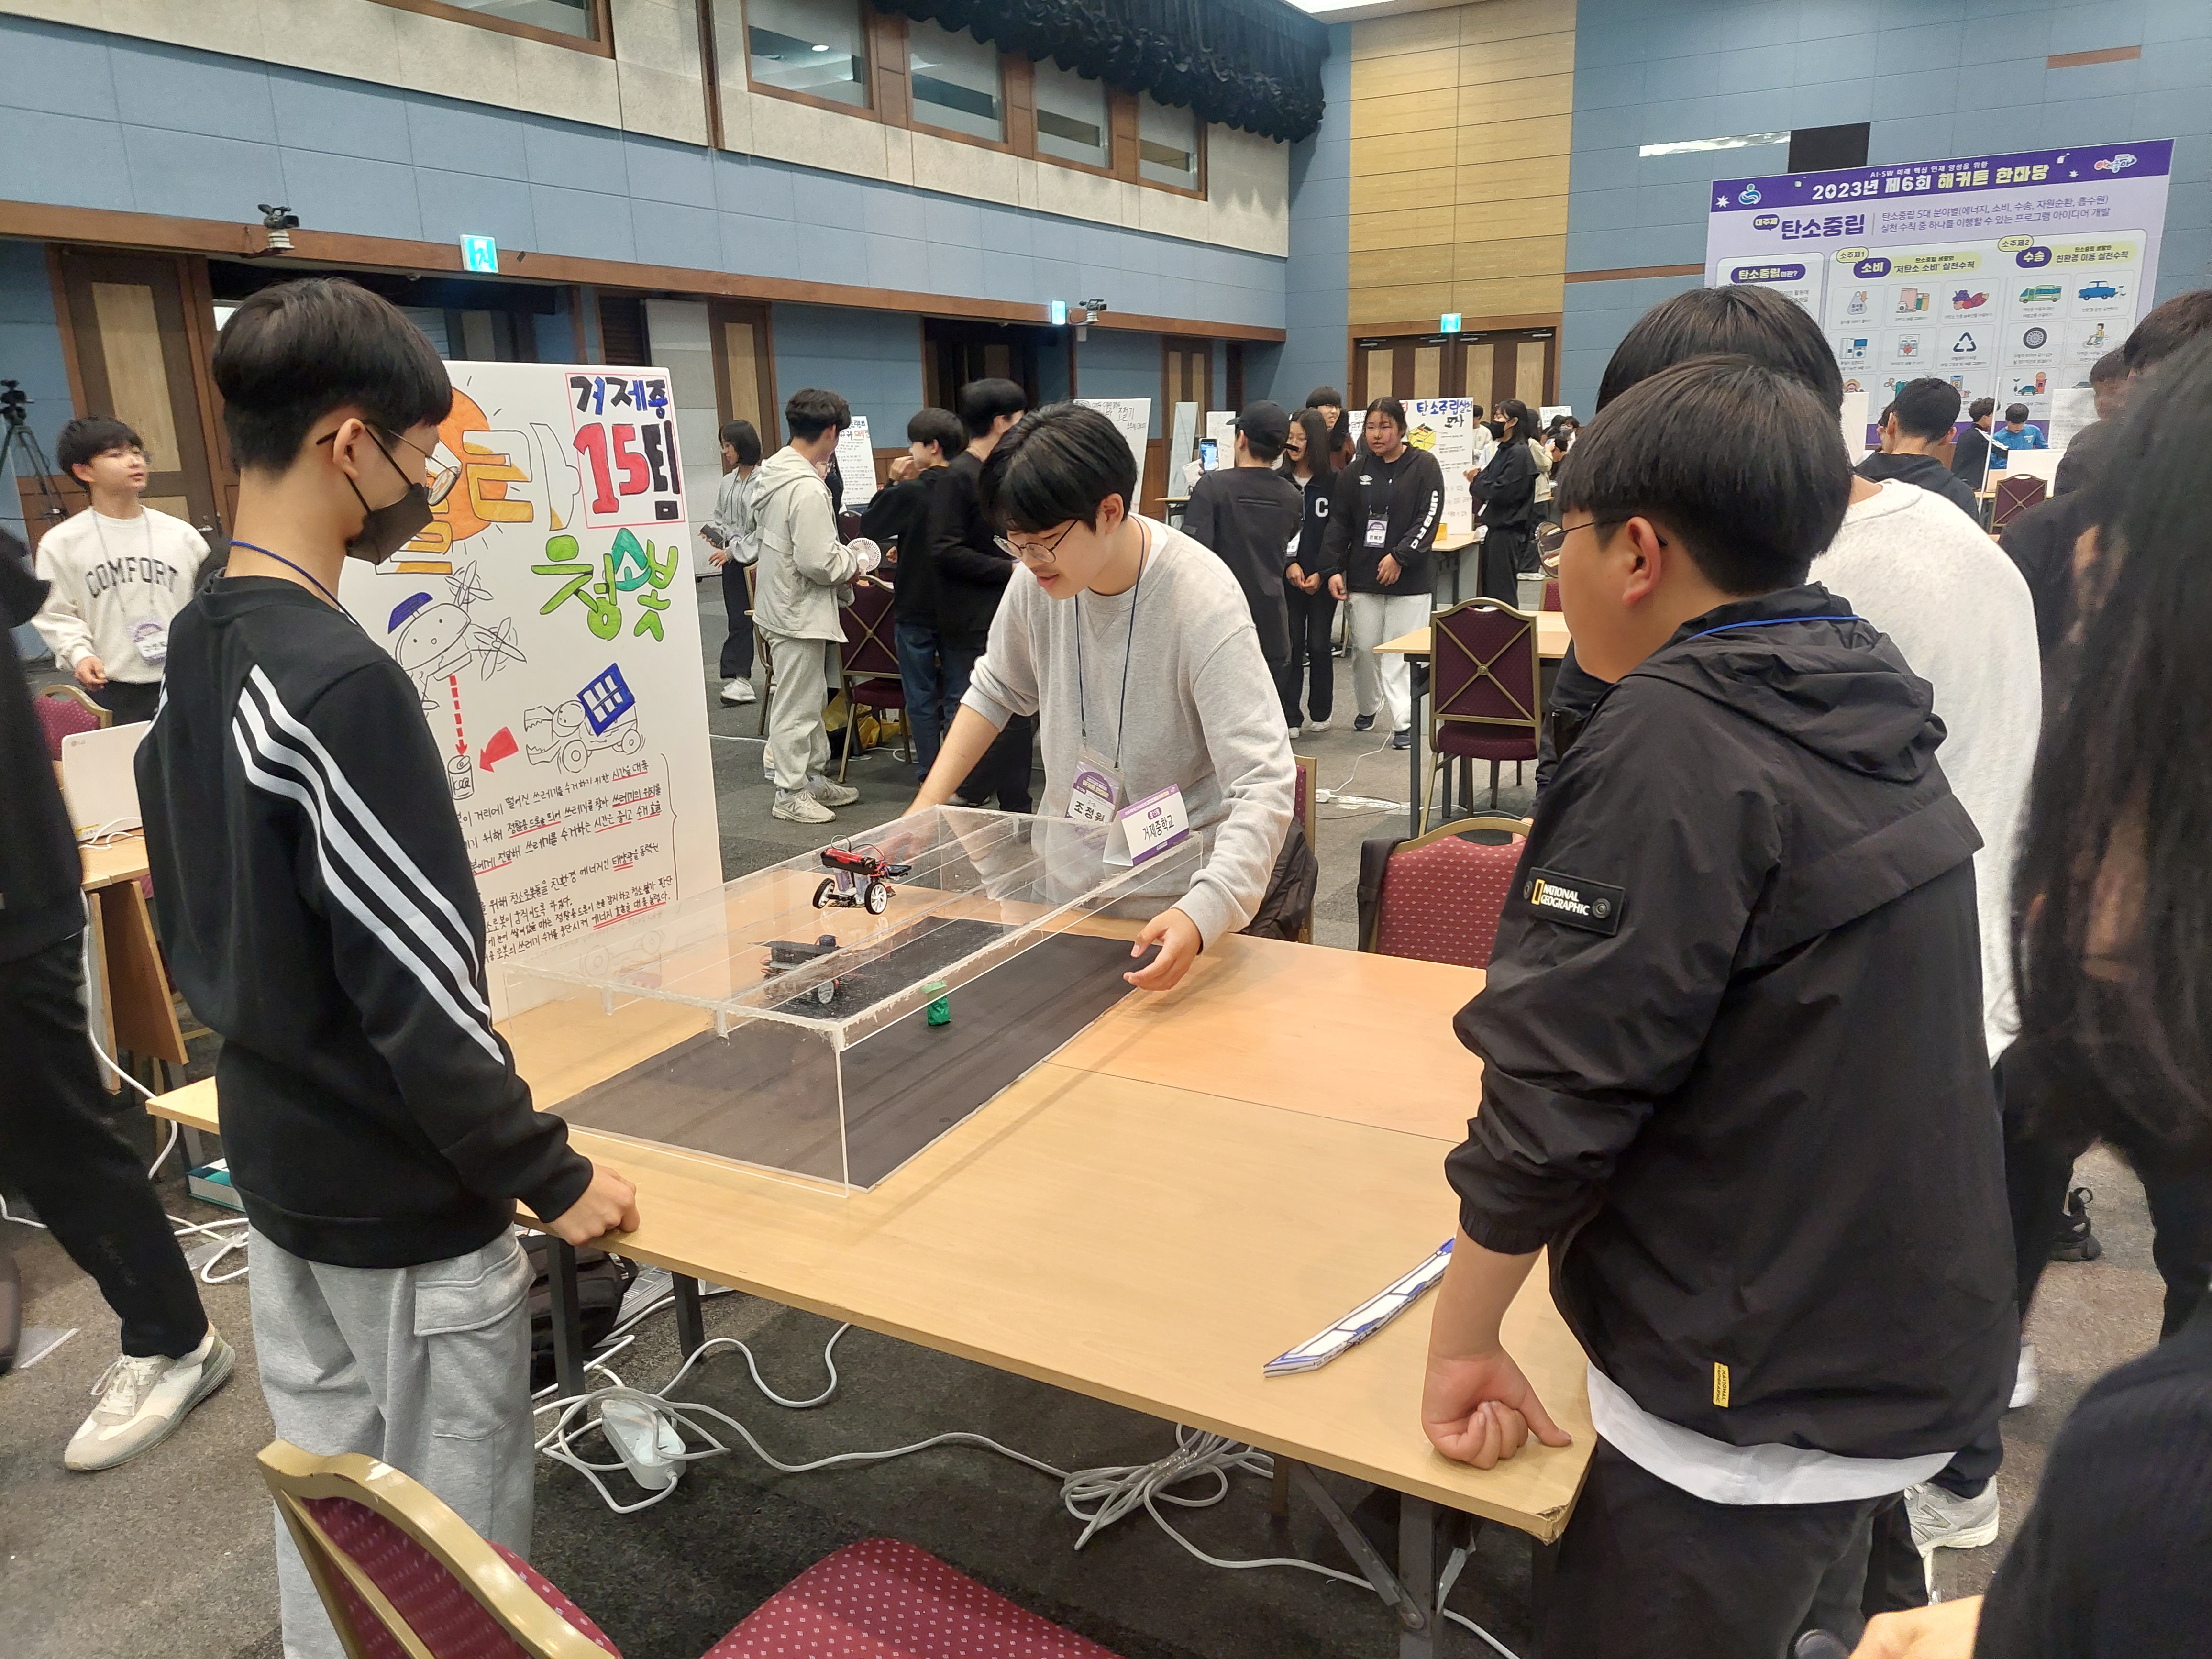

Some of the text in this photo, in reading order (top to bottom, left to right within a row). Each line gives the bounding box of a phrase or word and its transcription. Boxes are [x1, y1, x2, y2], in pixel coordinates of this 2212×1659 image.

[1948, 162, 1970, 172] 양성을
[1972, 161, 1989, 169] 위한
[1812, 165, 2050, 200] 2023년 제6회 해커톤 한마당
[1880, 207, 2110, 233] 실천 수칙 중 하나를 이행할 수 있는 프로그램 아이디어 개발
[1882, 195, 2109, 221] 탄소중립 5대 분야별(에너지, 소비, 수송, 자원순환, 흡수원)
[1781, 213, 1865, 240] 탄소중립
[1839, 250, 1866, 260] 소주제1
[2001, 239, 2029, 247] 소주제2
[1860, 262, 1885, 273] 소비
[1942, 261, 1975, 270] 실천수칙
[2023, 251, 2046, 263] 수송
[2056, 253, 2079, 263] 친환경
[2080, 253, 2096, 261] 이동
[570, 376, 668, 419] 거제중
[574, 420, 681, 520] 15팀
[1315, 498, 1329, 517] C
[85, 556, 178, 598] COMFORT
[474, 803, 504, 820] 거리에
[505, 794, 530, 809] 떨어진
[533, 786, 563, 803] 쓰레기를
[565, 777, 592, 794] 수거하기
[594, 773, 609, 785] 위한
[612, 765, 631, 780] 시간을
[632, 760, 649, 772] 대폭
[482, 829, 503, 843] 위해
[564, 799, 593, 818] 쓰레기를
[595, 796, 609, 811] 찾아
[1074, 800, 1106, 822] 조정원
[498, 845, 521, 862] 전달해
[525, 831, 558, 854] 쓰레기를
[560, 821, 591, 841] 수거하는
[594, 813, 615, 828] 시간은
[1142, 814, 1175, 841] 거제중학교
[488, 896, 508, 914] 위해
[509, 879, 549, 905] 청소로봇들을
[551, 869, 577, 891] 친환경
[579, 858, 609, 876] 에너지인
[611, 849, 639, 864] 태양광을
[640, 842, 659, 857] 동력원
[538, 917, 553, 929] 때는
[607, 891, 630, 905] 감지하고
[658, 875, 673, 888] 판단
[1540, 895, 1591, 916] GEOGRAPHIC
[1543, 884, 1580, 902] NATIONAL
[497, 943, 517, 959] 로봇의
[518, 934, 541, 953] 쓰레기
[560, 918, 589, 938] 중단시켜
[591, 908, 613, 924] 에너지
